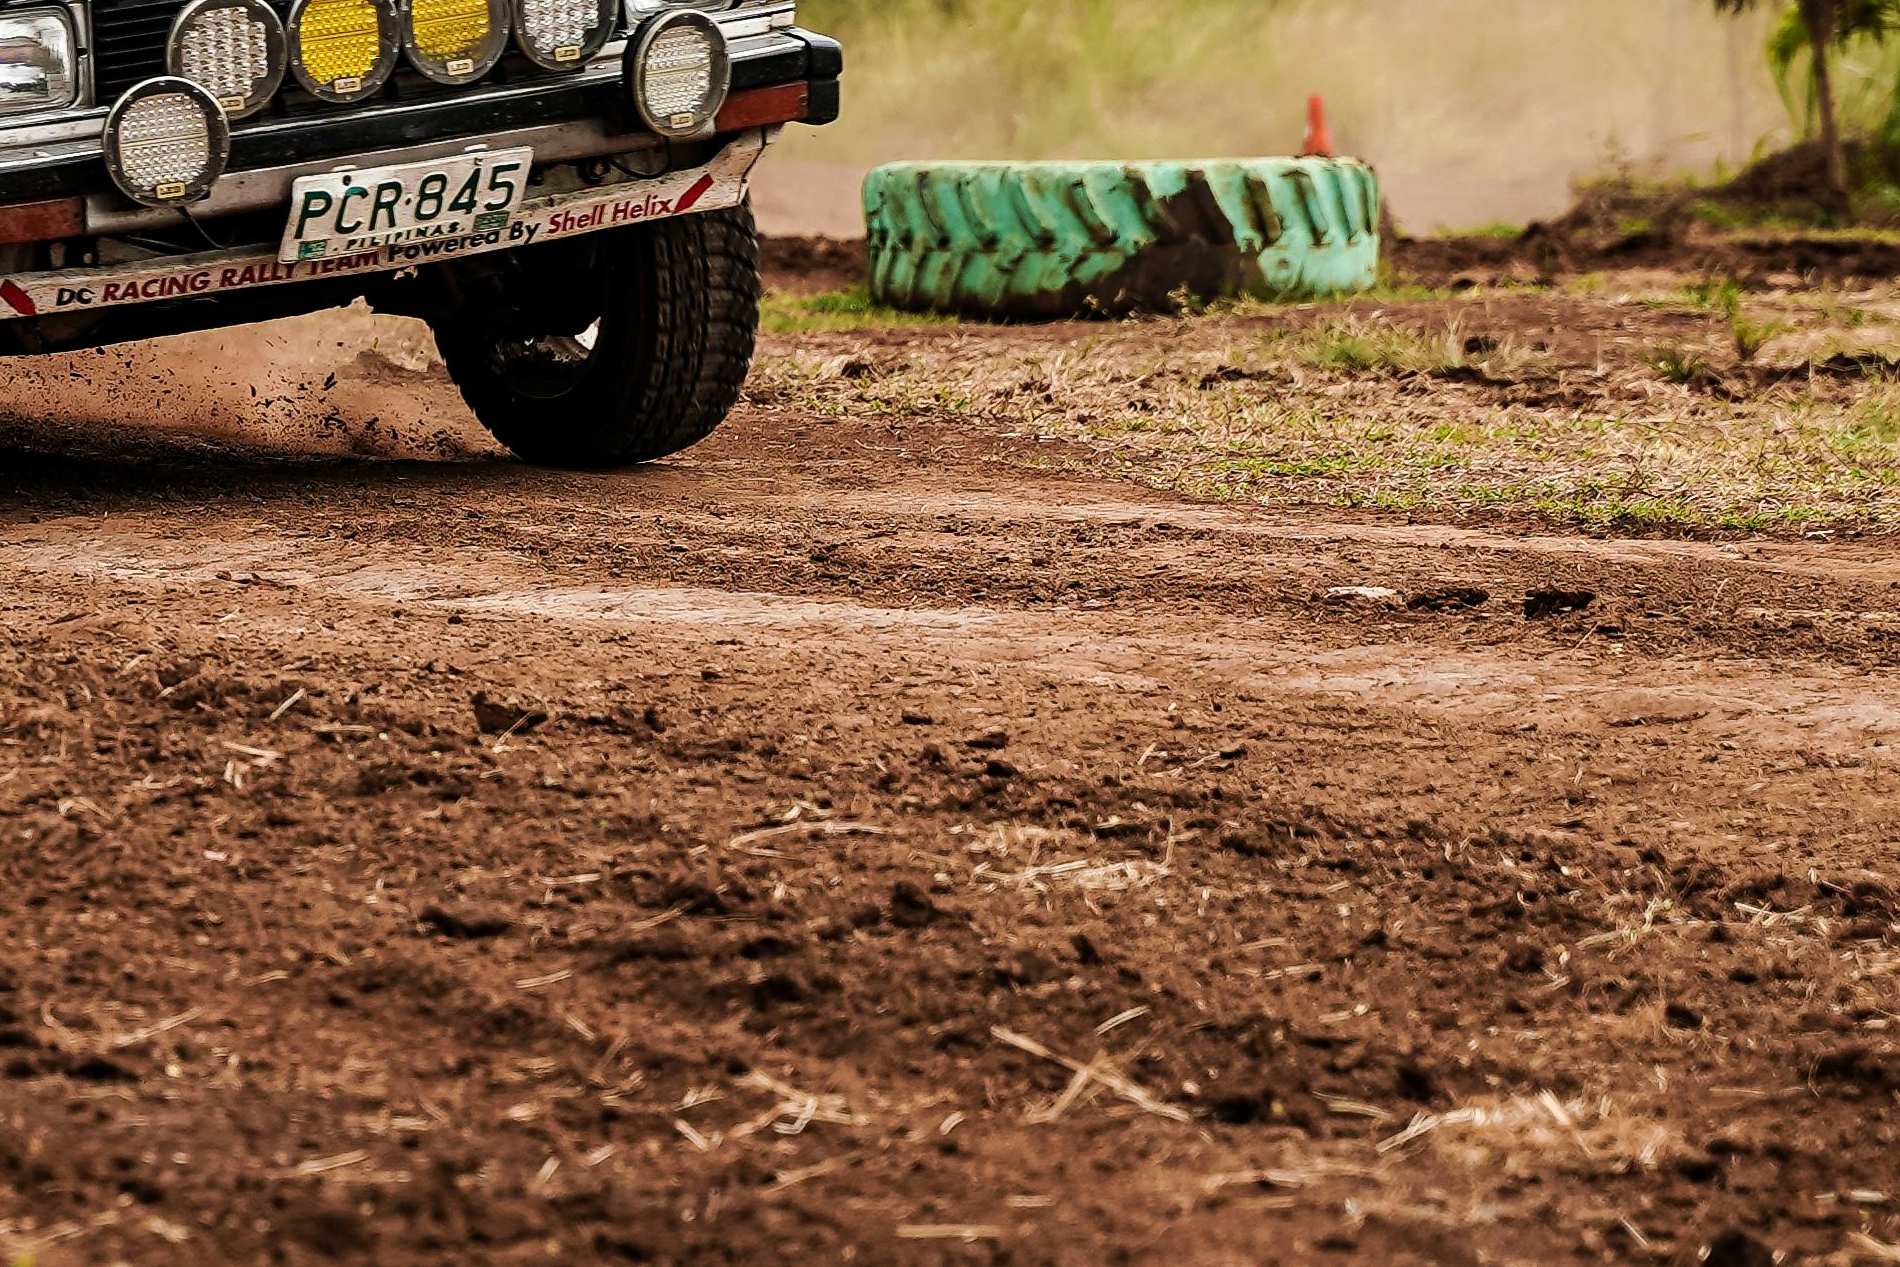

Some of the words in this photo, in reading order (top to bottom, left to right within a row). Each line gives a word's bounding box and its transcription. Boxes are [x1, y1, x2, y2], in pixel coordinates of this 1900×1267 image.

[56, 287, 95, 307] DC
[102, 271, 213, 303] RACING
[509, 220, 540, 245] By
[548, 203, 605, 235] Shell
[611, 195, 674, 224] Helix
[344, 221, 460, 251] PILIPINAS
